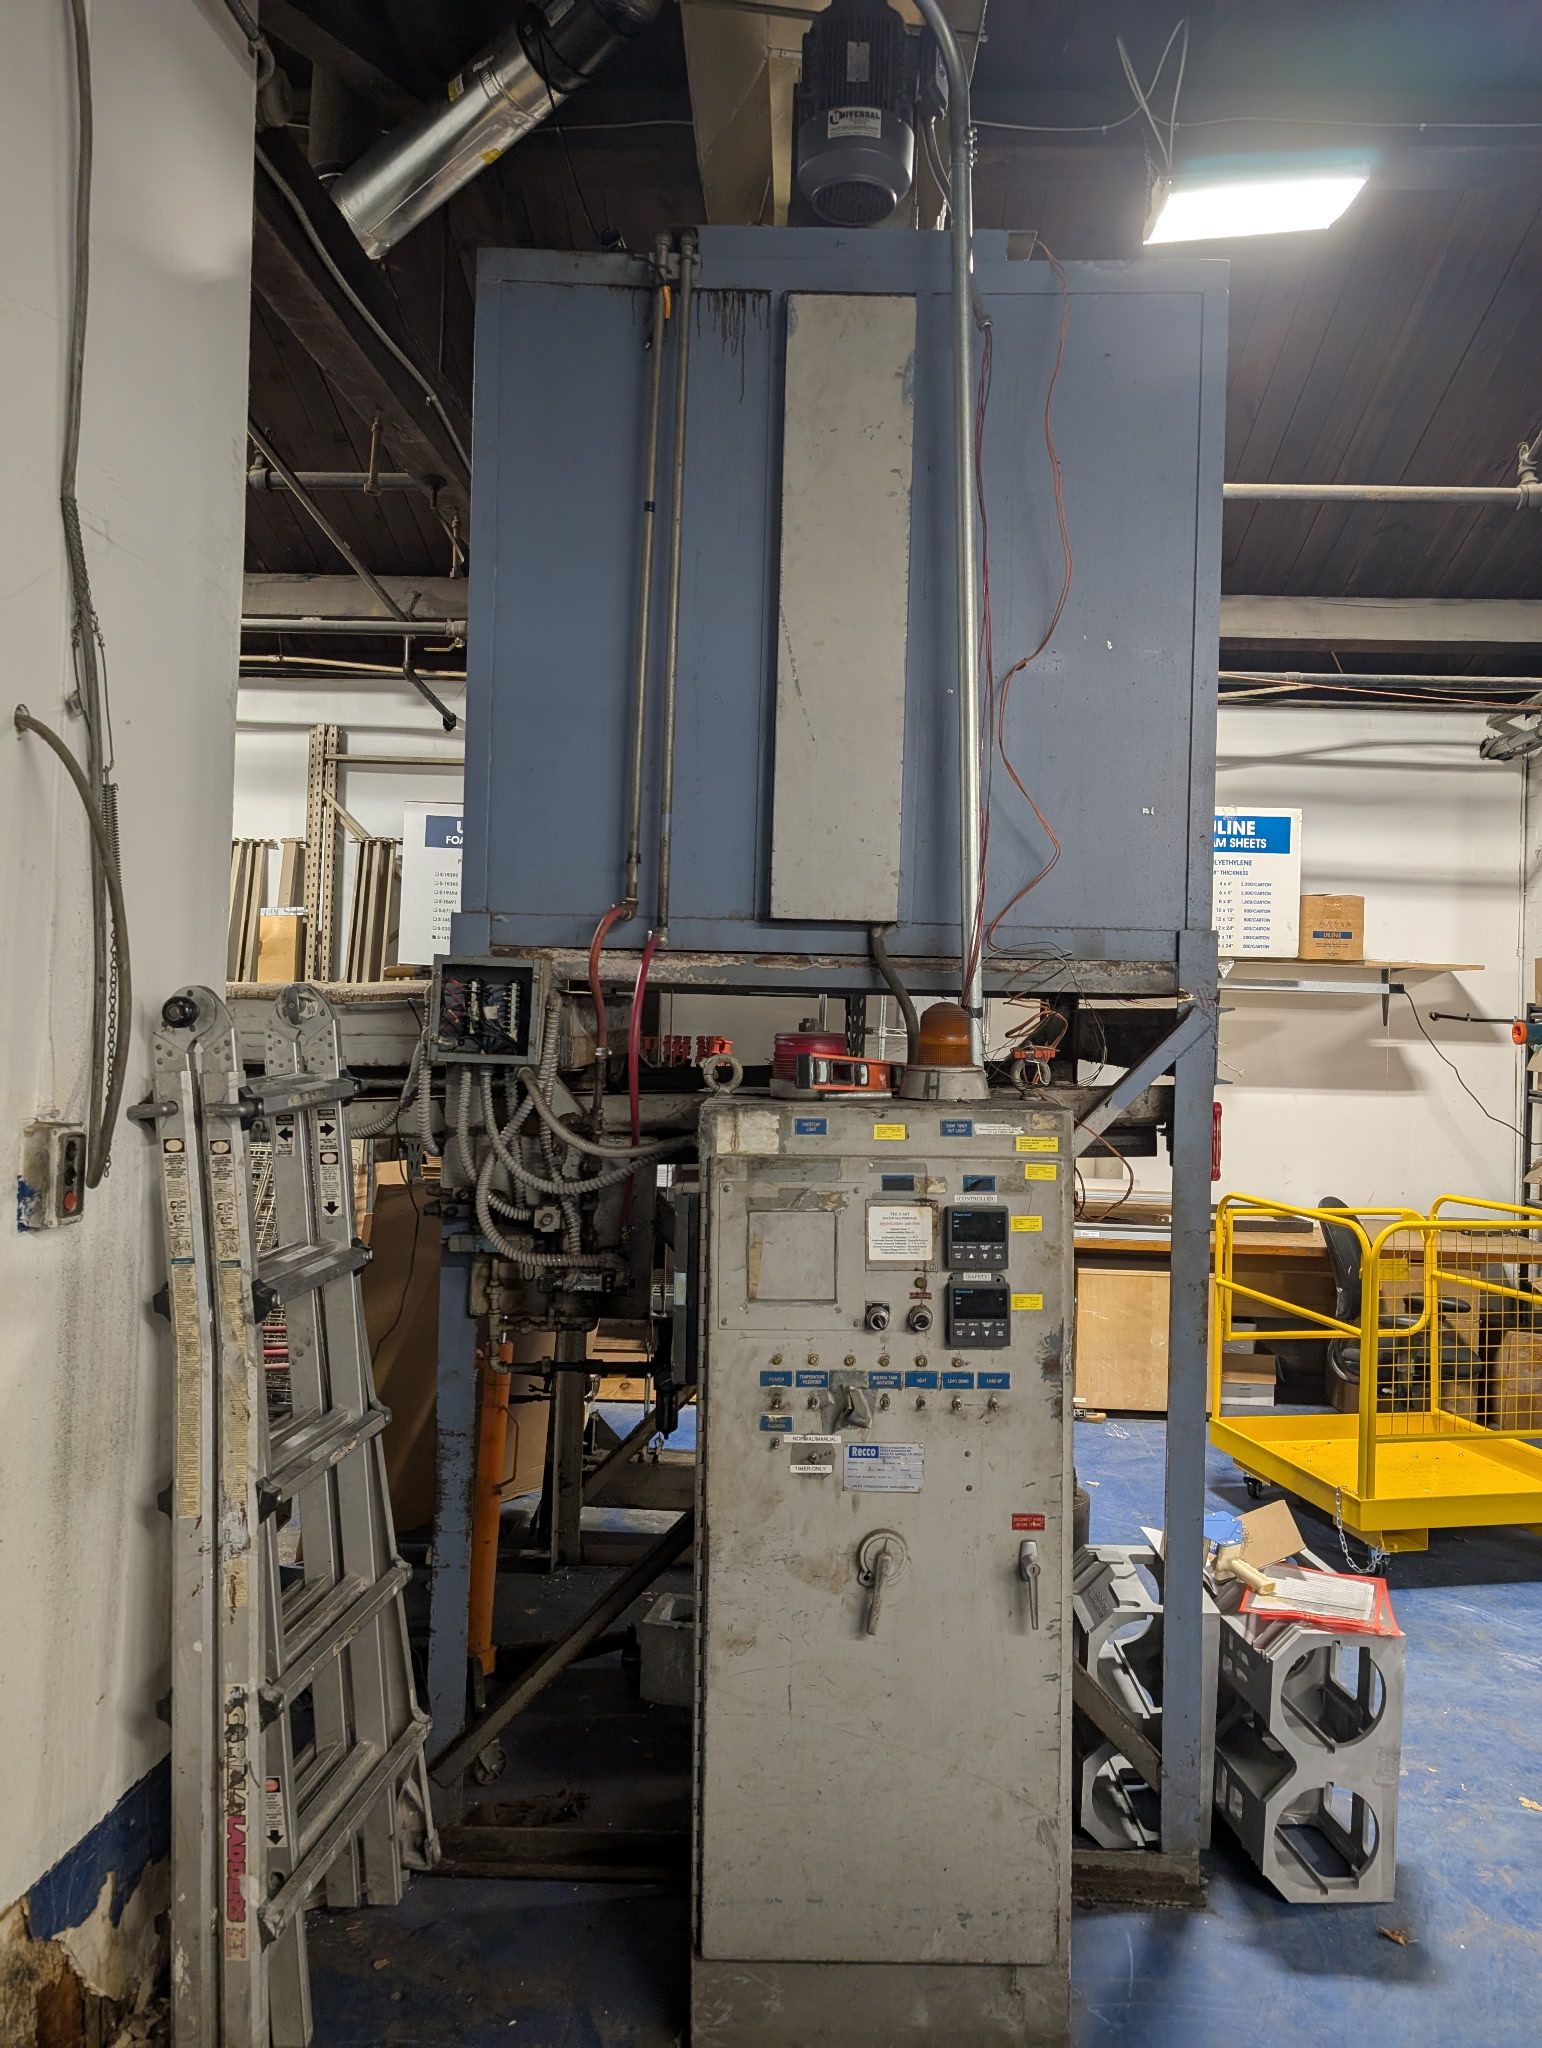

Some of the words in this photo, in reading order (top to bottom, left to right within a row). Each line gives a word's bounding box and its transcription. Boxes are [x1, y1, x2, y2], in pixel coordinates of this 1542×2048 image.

[1229, 837, 1267, 849] SHEETS
[851, 1446, 877, 1457] Recco
[226, 1815, 247, 1923] LADDERS
